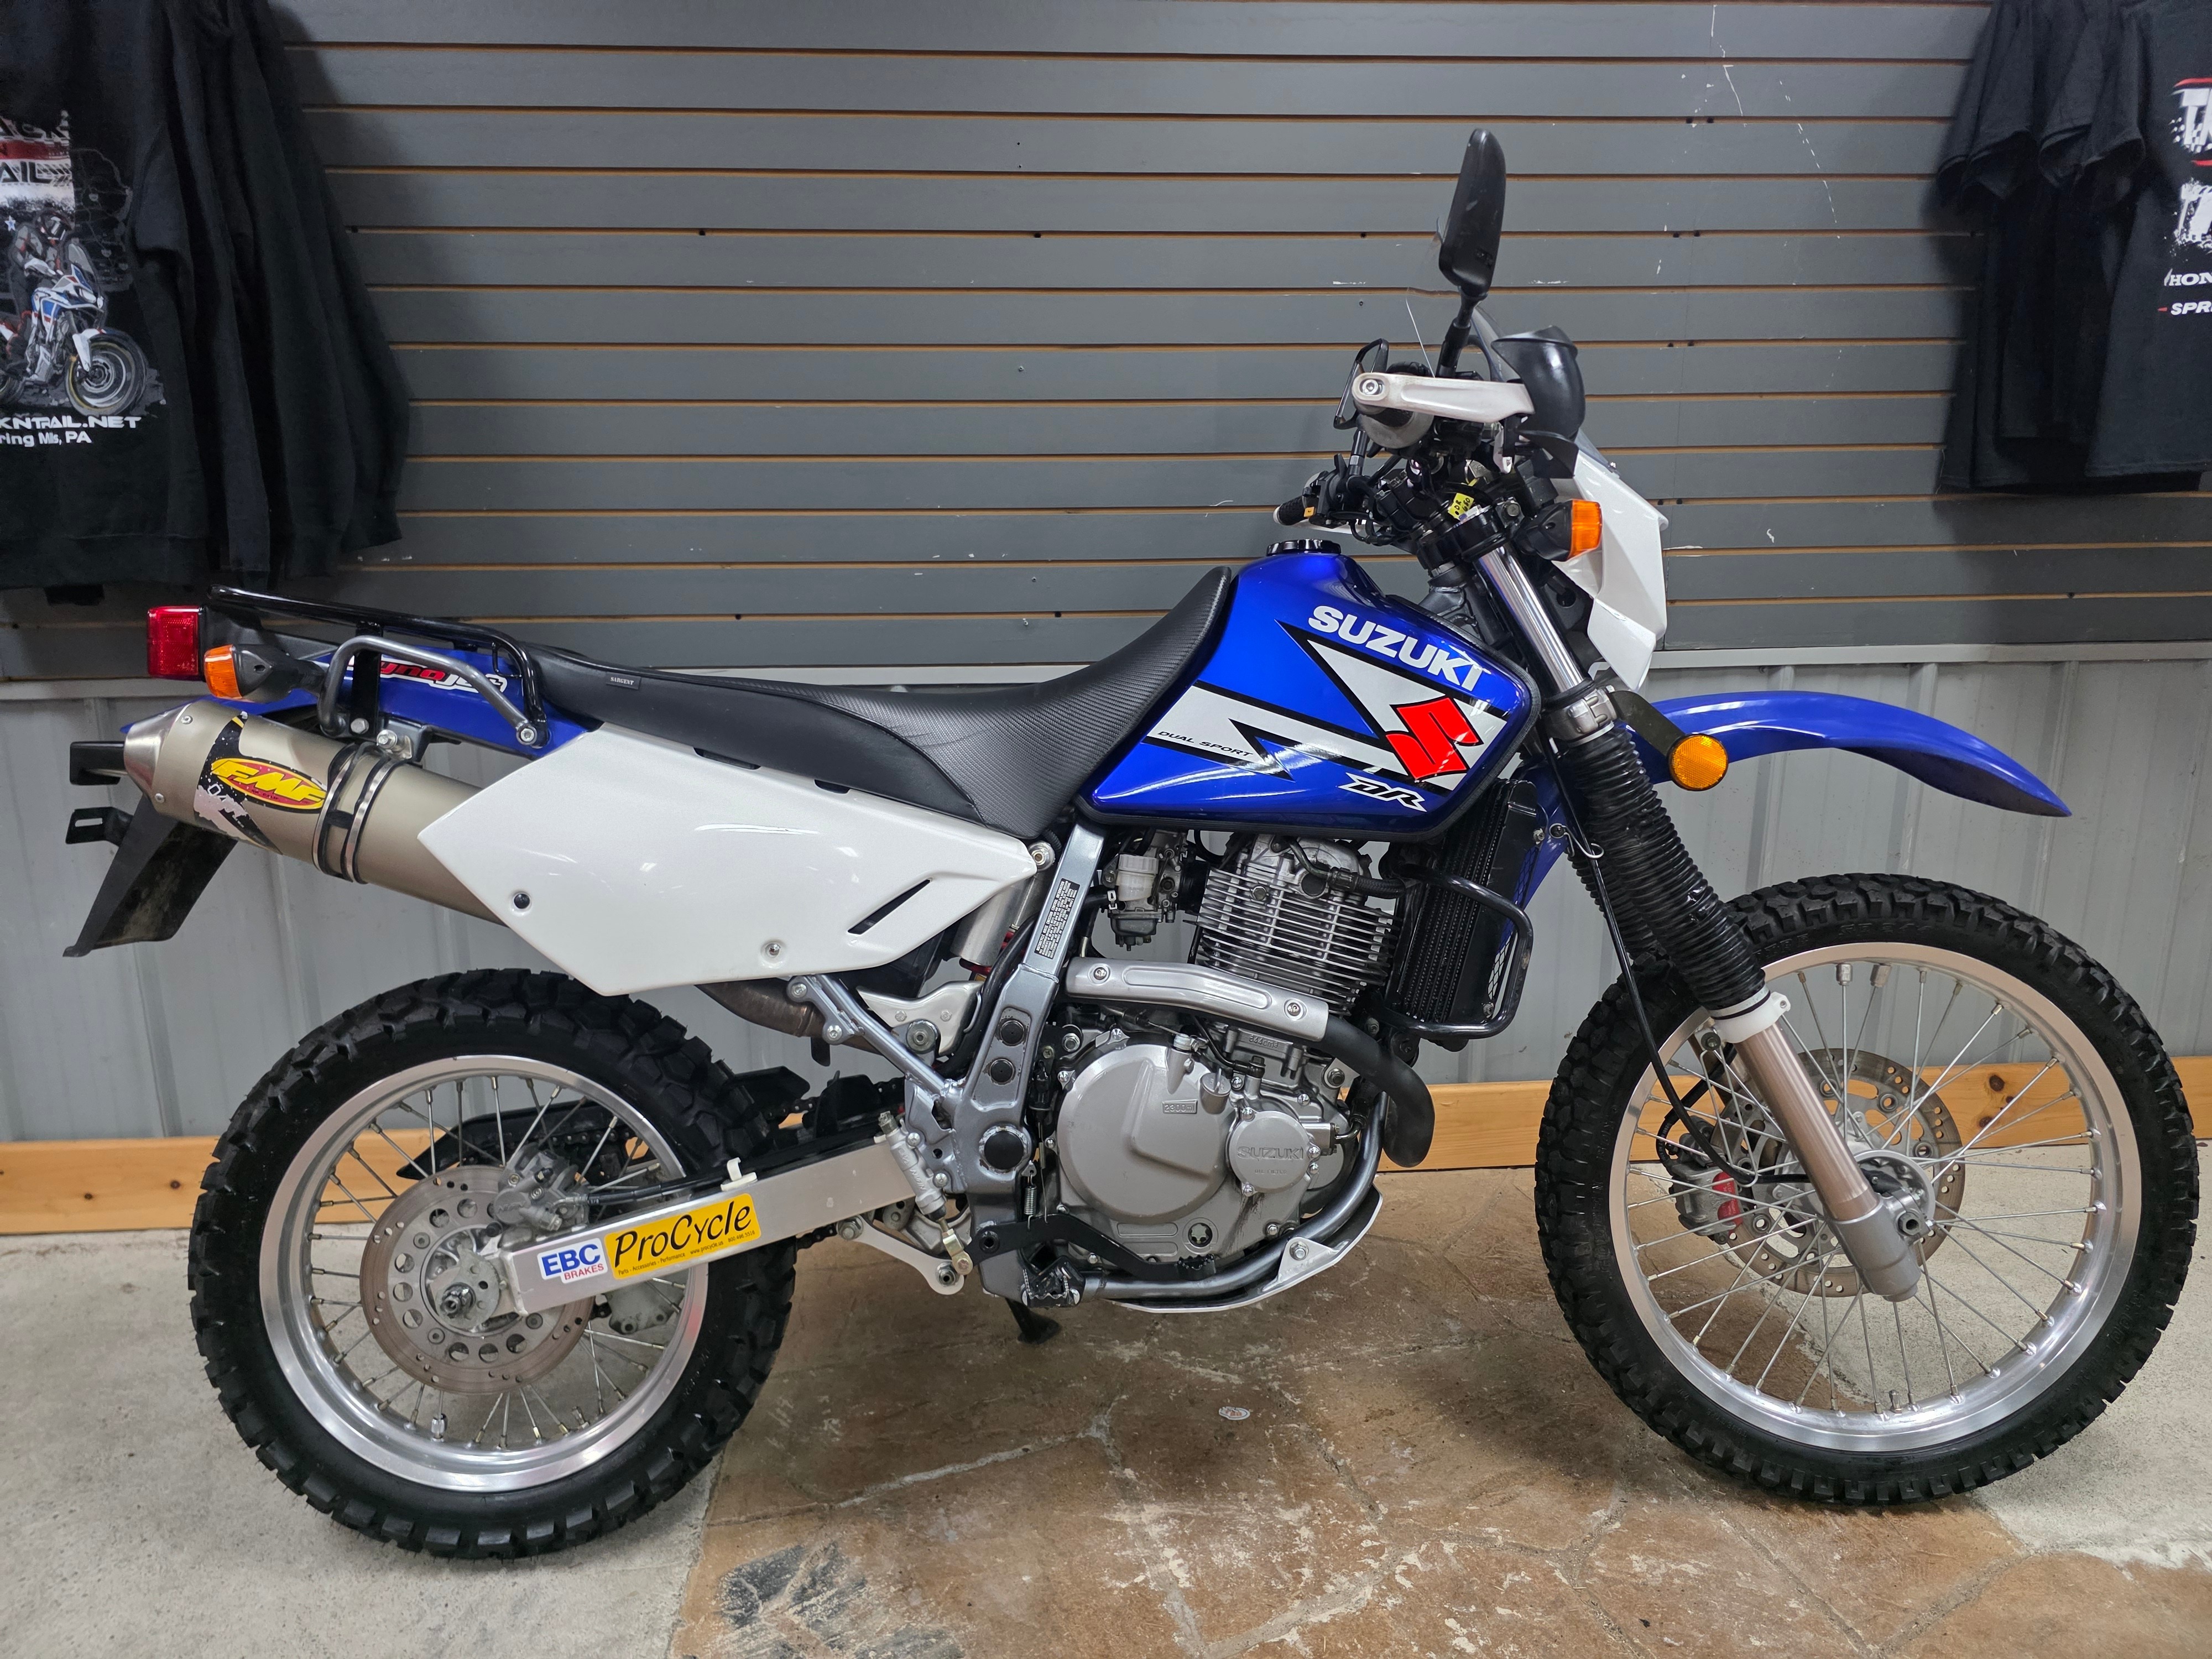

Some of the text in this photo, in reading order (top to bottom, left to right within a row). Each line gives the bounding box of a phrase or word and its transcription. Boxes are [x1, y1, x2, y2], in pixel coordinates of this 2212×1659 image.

[65, 431, 92, 443] PA
[1308, 606, 1483, 691] SUZUKI
[610, 676, 634, 685] SARGENT
[1157, 731, 1254, 757] DUAL SPORT
[211, 760, 327, 802] FMF
[1237, 1146, 1304, 1160] SUZUKI
[615, 1200, 752, 1268] ProCycle
[541, 1243, 601, 1277] EBC
[564, 1264, 604, 1281] BRAKES
[618, 1266, 629, 1276] Parts
[632, 1260, 657, 1272] Accessories
[660, 1251, 686, 1264] Performance
[689, 1240, 724, 1255] www.procycle.us
